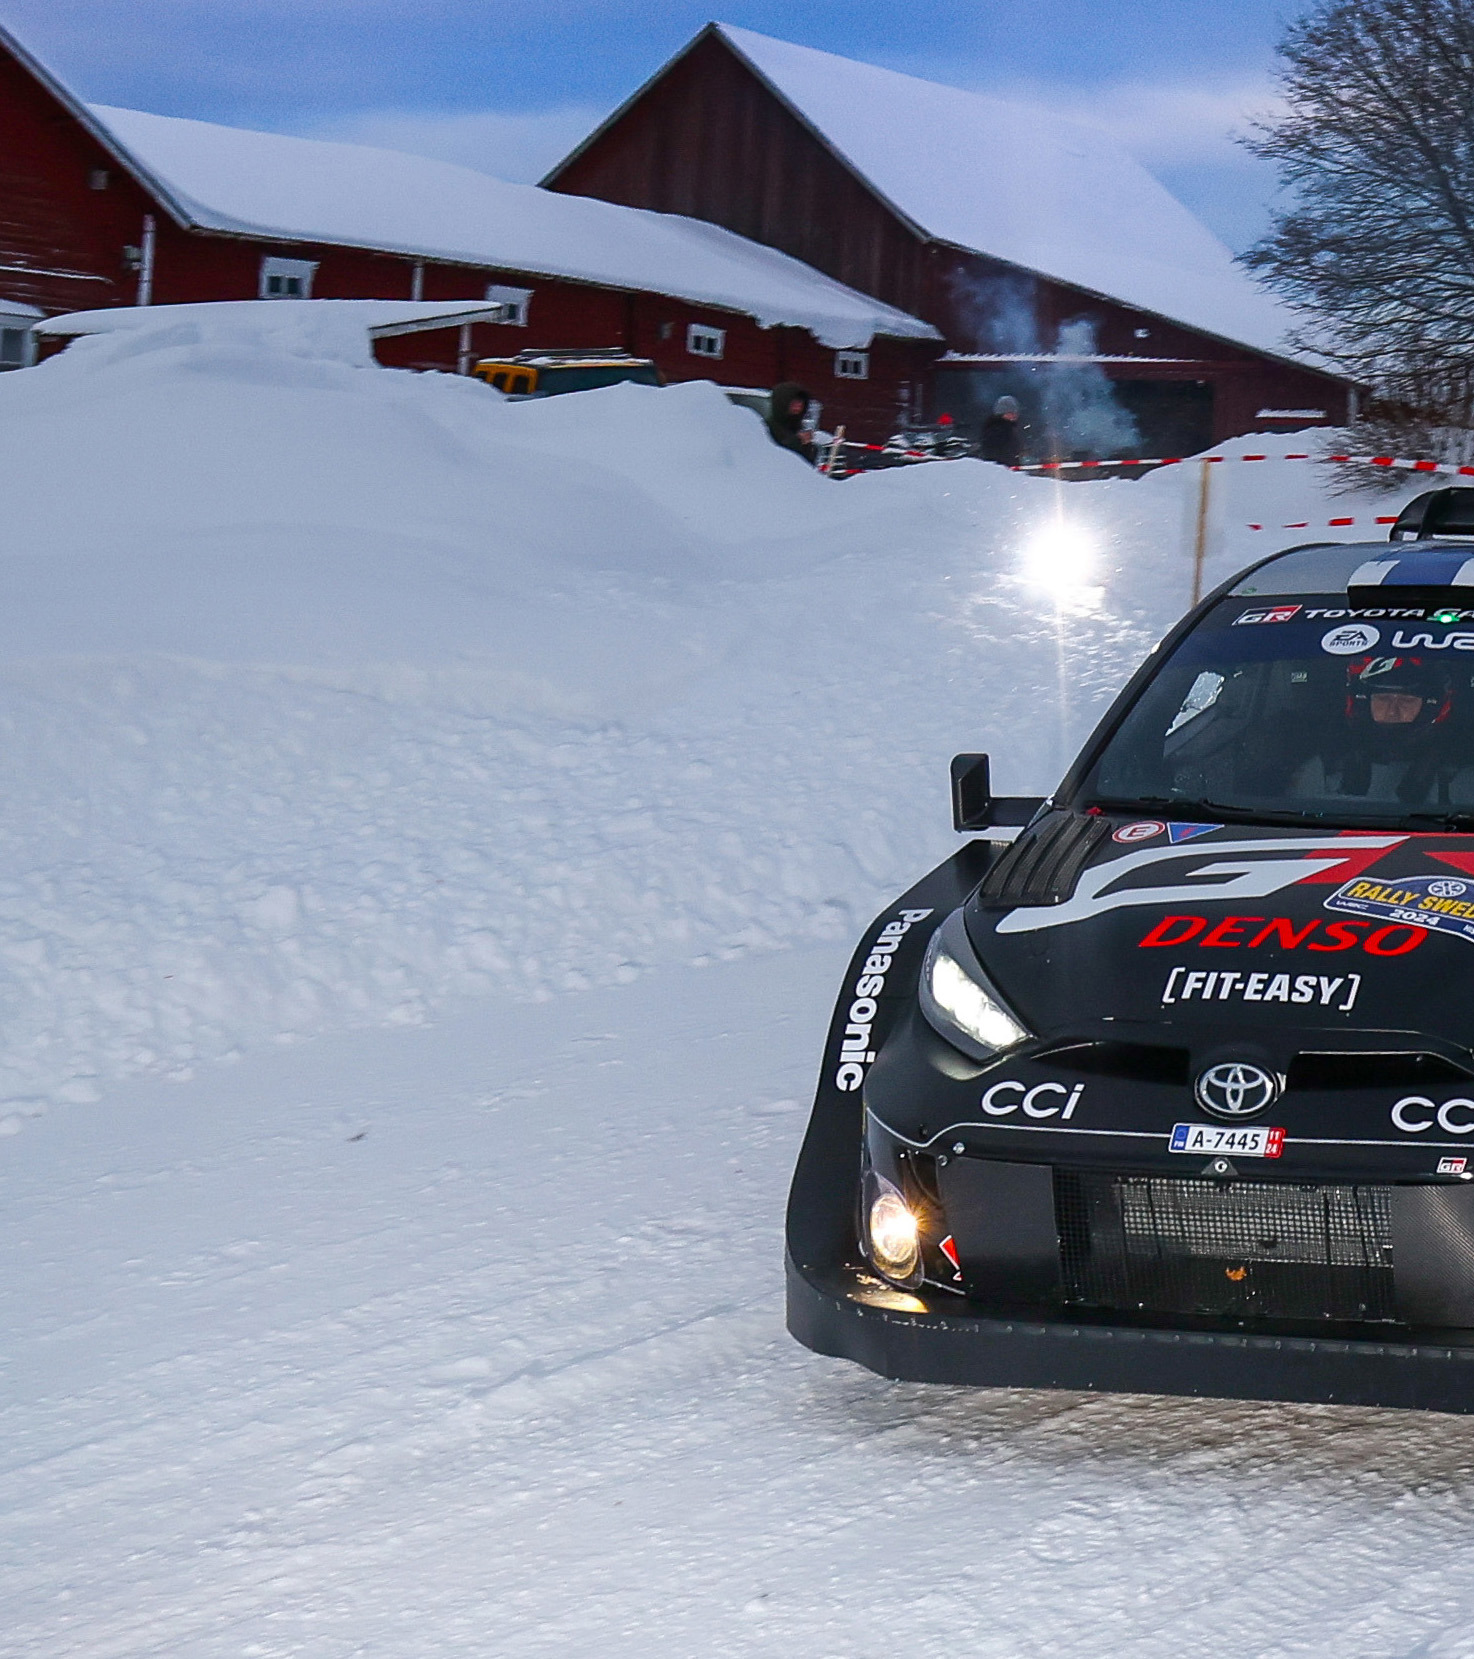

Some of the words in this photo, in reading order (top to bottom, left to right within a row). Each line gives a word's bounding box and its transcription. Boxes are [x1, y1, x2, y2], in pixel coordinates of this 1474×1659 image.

[1236, 609, 1294, 624] GR
[1304, 608, 1426, 619] TOYOTA
[1333, 630, 1368, 641] EA
[1347, 881, 1420, 904] RALLY
[1389, 908, 1440, 926] 2024
[1139, 915, 1428, 957] DENSO
[836, 908, 934, 1091] Panasonic
[1192, 1130, 1260, 1150] A-7445
[1269, 1131, 1280, 1140] 11
[1266, 1143, 1278, 1153] 24
[1438, 1160, 1465, 1172] GR
